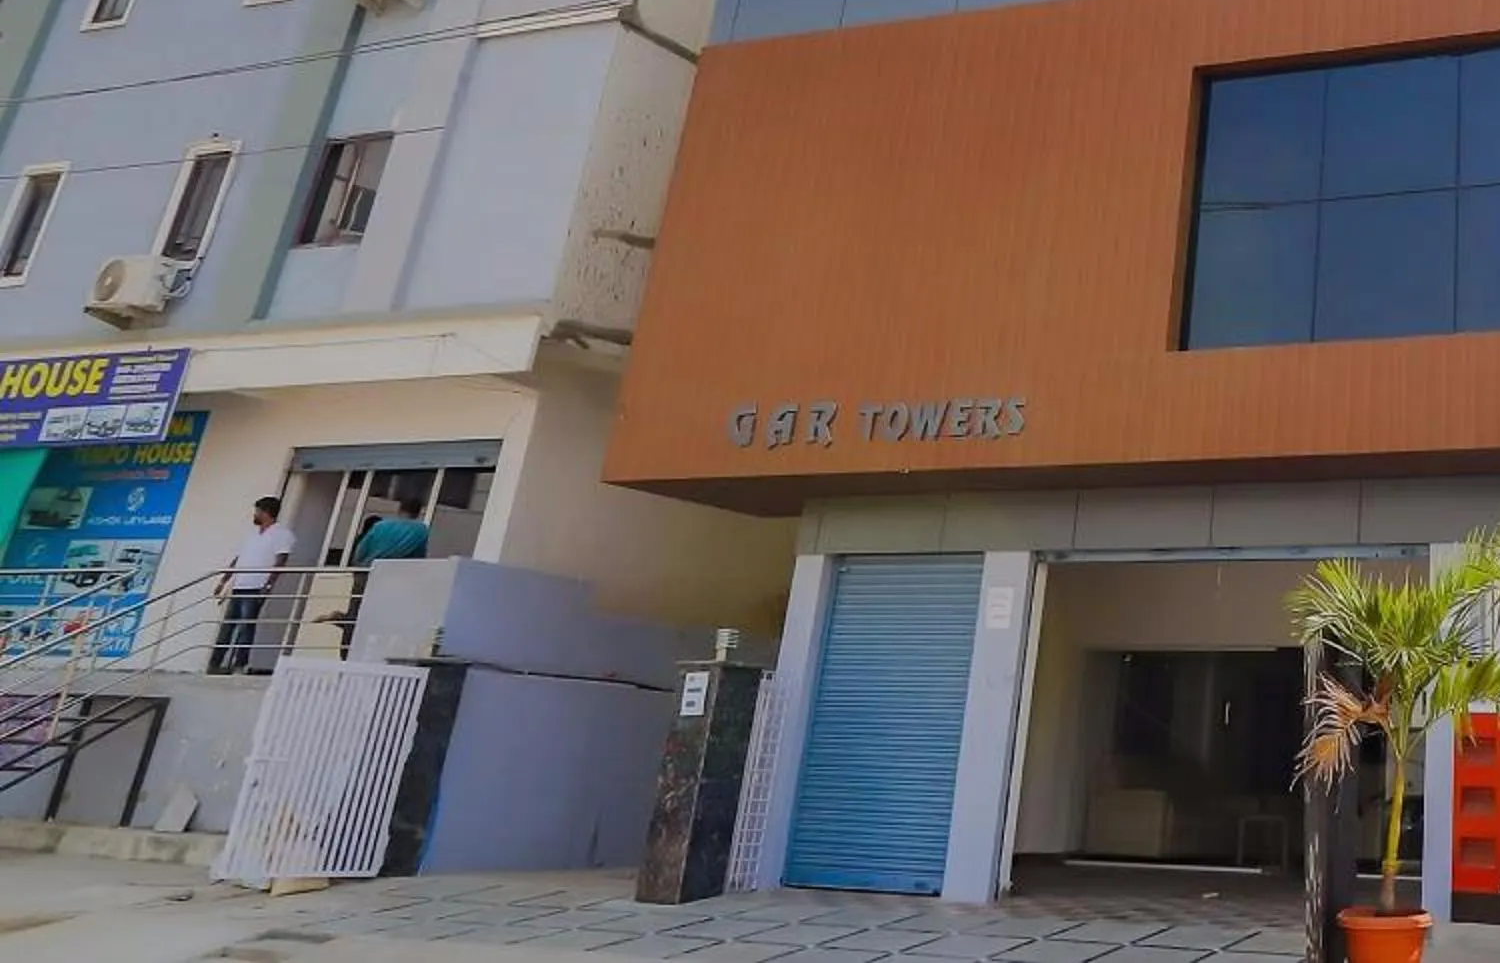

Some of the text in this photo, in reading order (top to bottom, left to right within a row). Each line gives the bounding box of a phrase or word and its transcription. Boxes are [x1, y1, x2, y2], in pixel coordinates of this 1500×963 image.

[0, 358, 110, 399] HOUSE
[728, 395, 1027, 450] GAR TOWERS
[132, 440, 195, 464] HOUSE
